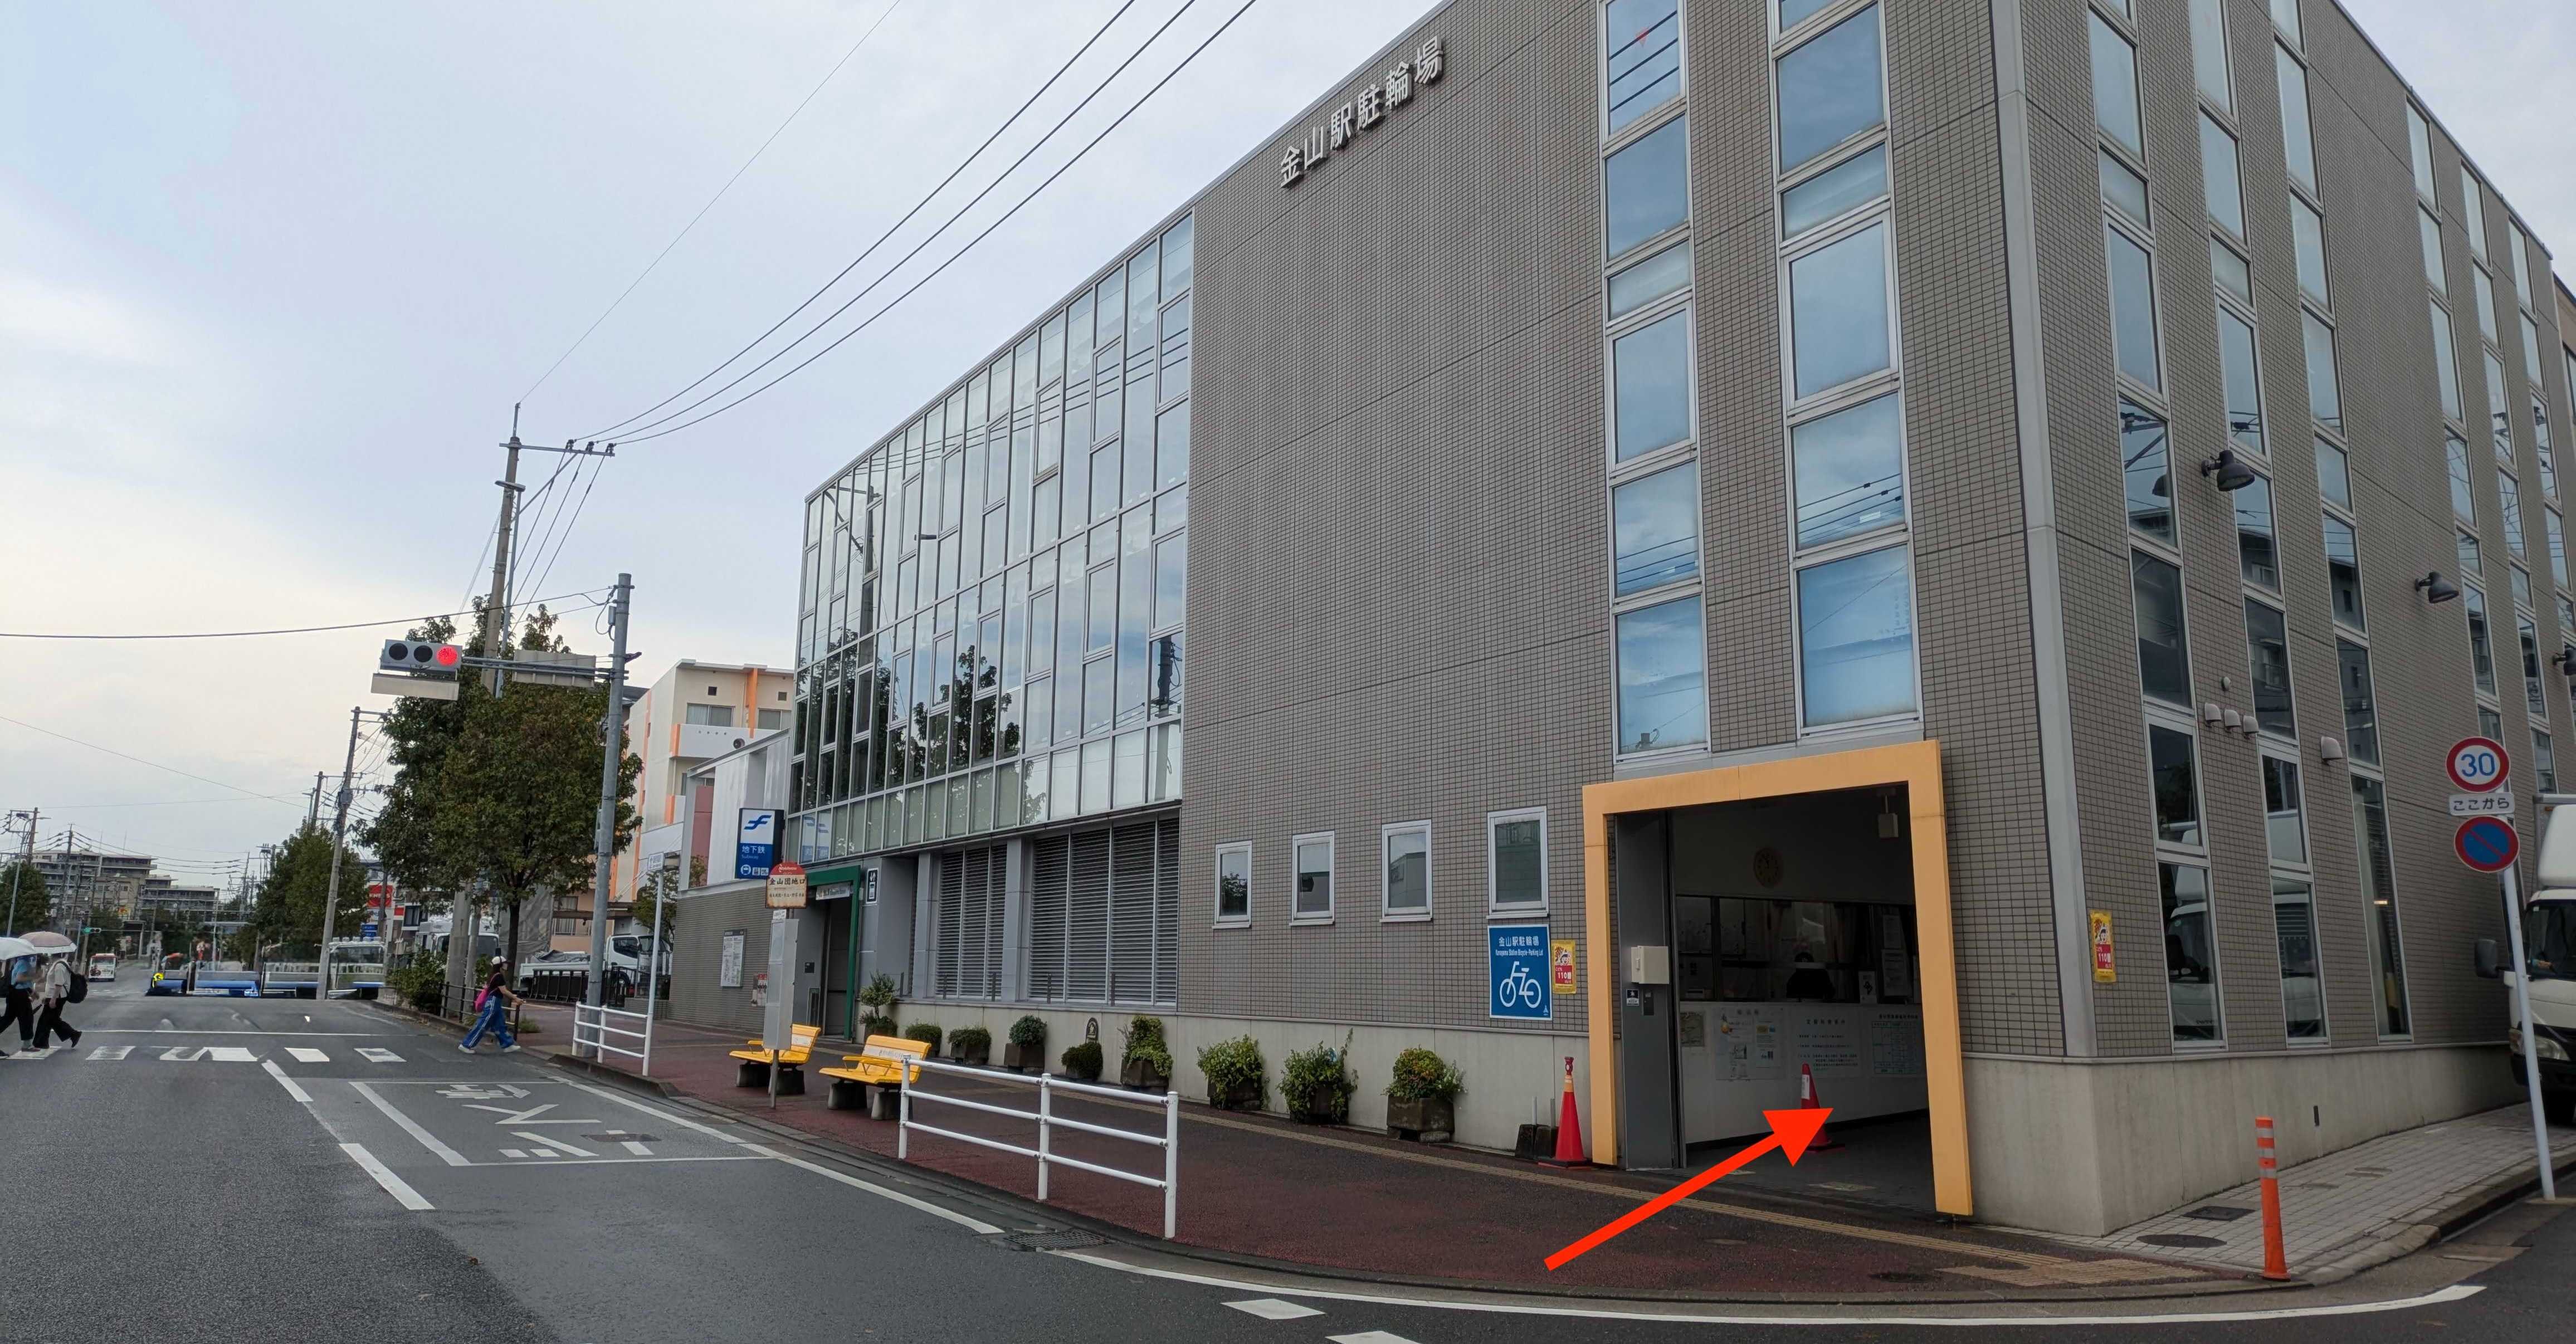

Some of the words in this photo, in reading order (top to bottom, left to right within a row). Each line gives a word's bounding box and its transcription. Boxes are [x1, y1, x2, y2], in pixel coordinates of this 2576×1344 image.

[1280, 35, 1444, 188] 金山駅駐輪場
[2461, 752, 2495, 777] 30
[2453, 798, 2510, 811] ここから
[741, 845, 765, 854] 地下鉄
[769, 877, 806, 886] 金山団地口
[1499, 936, 1539, 946] 金山駅駐輪場
